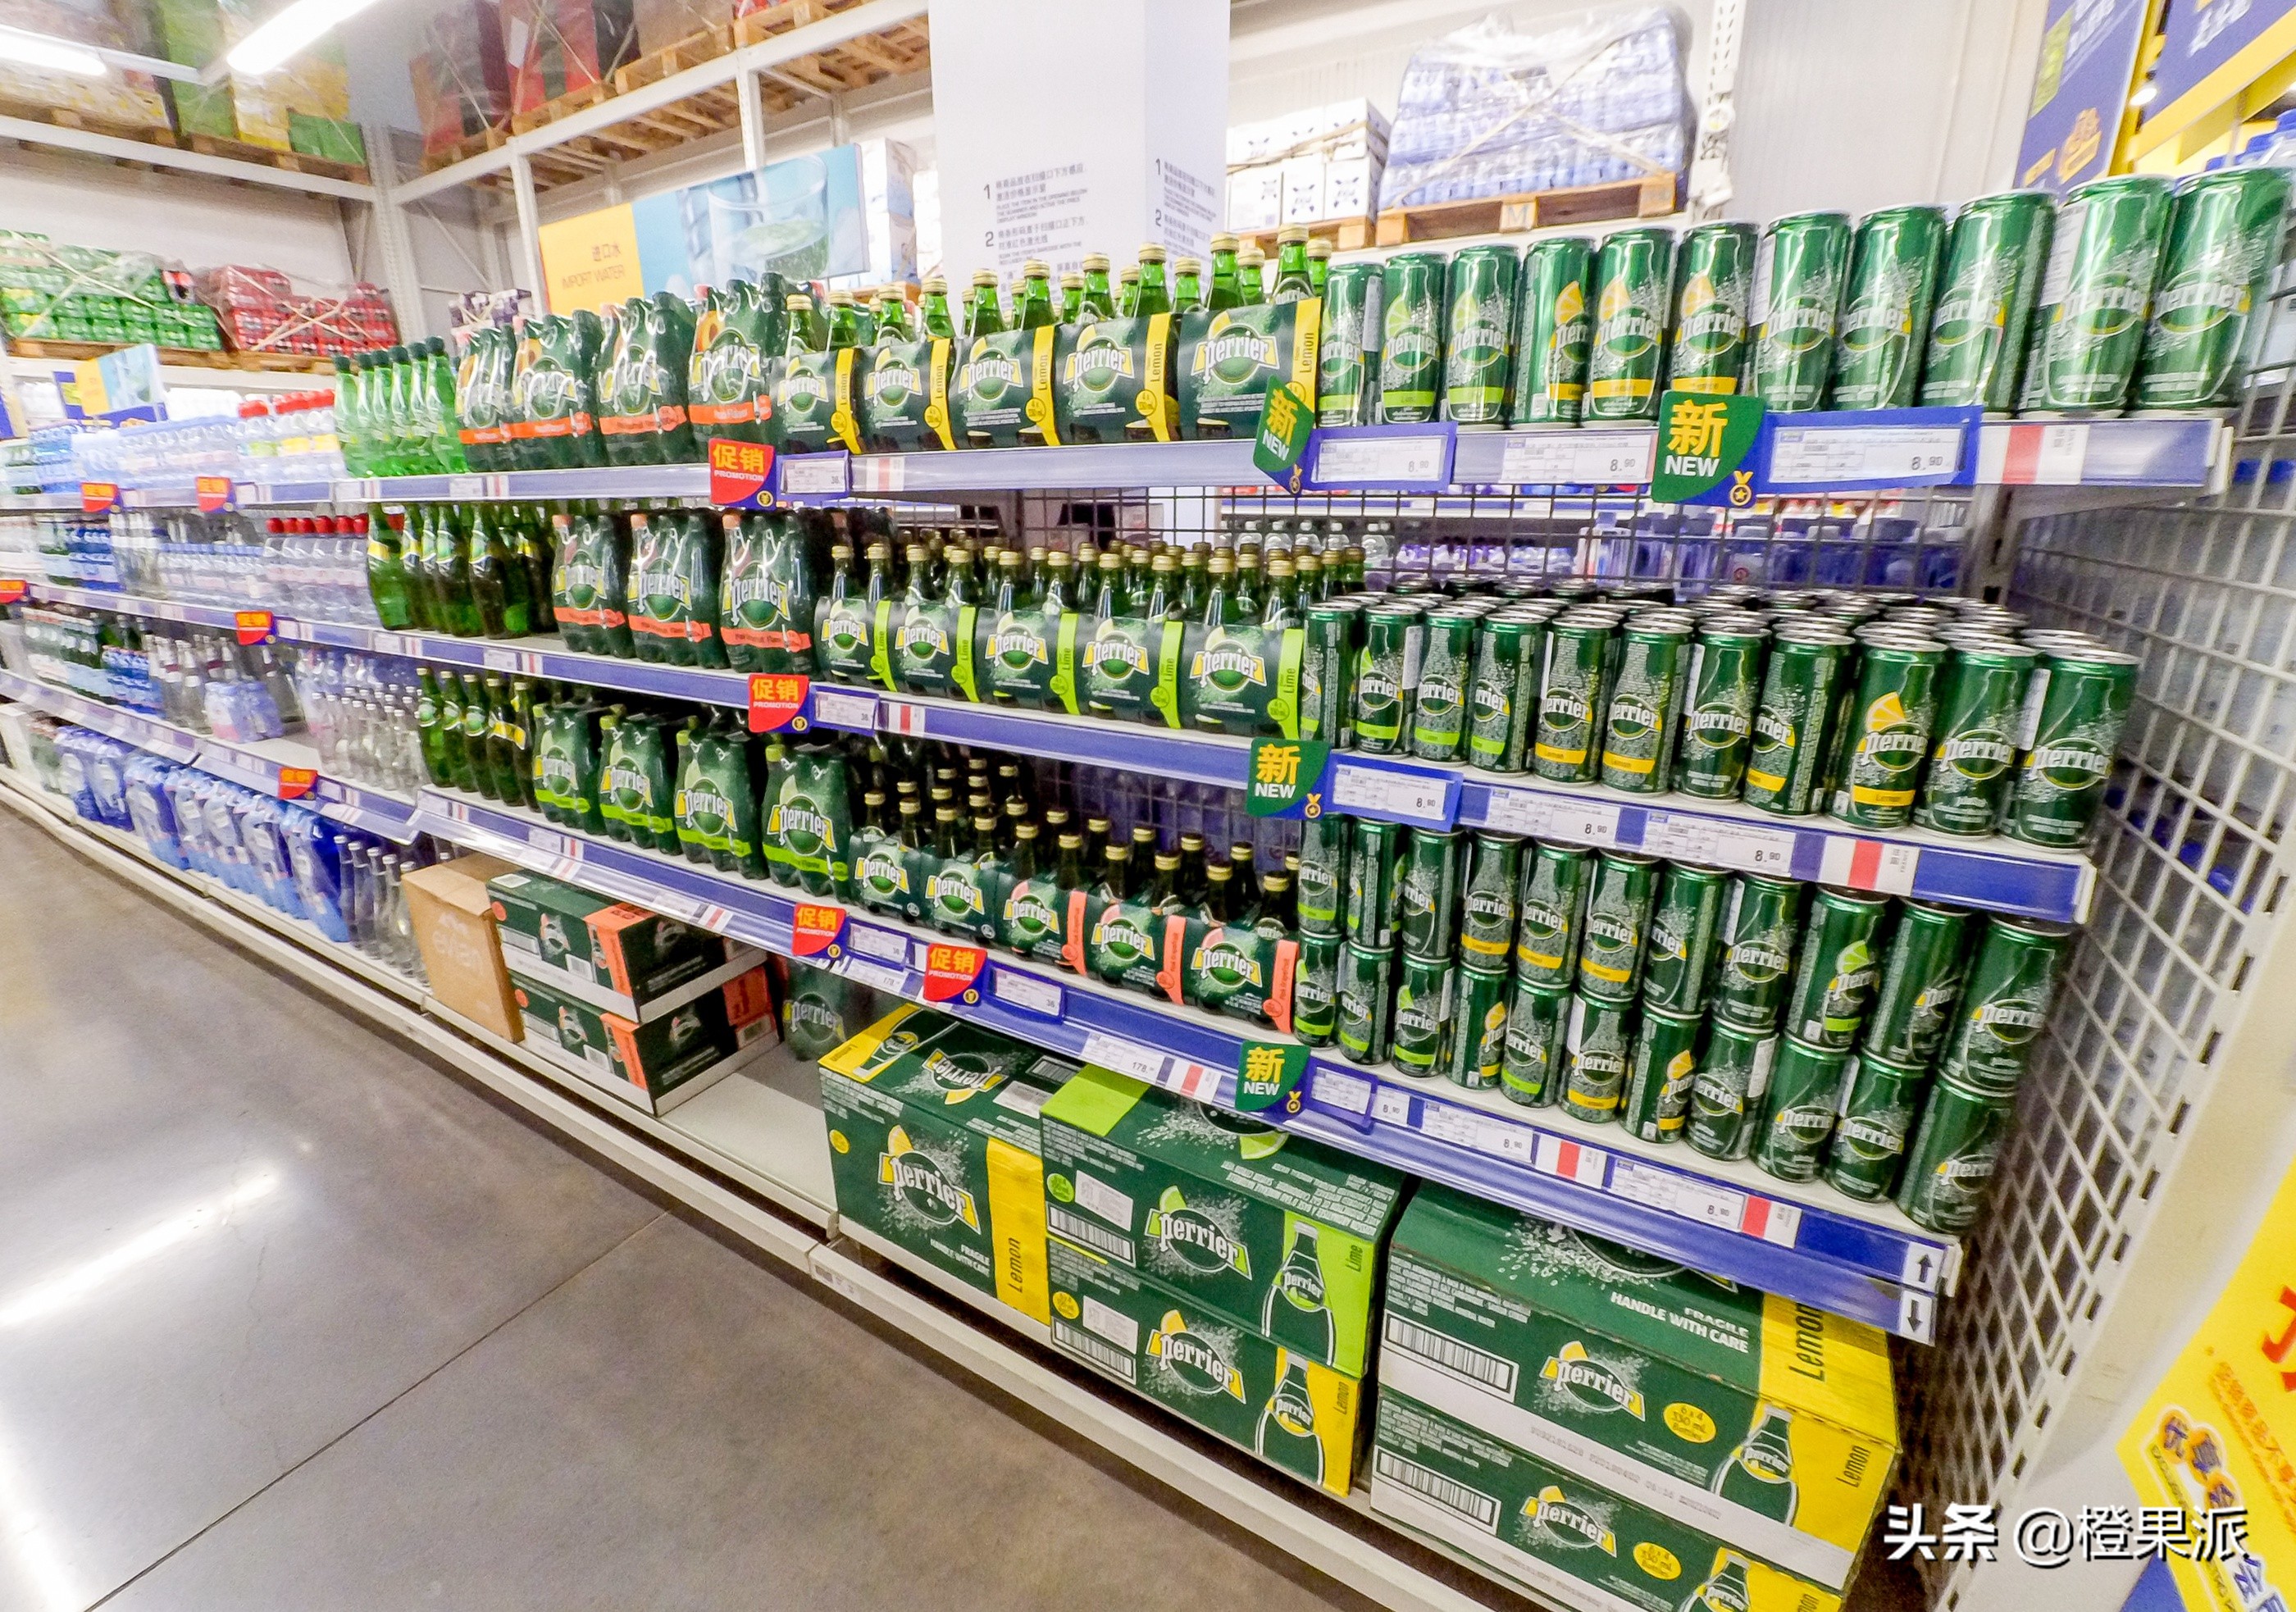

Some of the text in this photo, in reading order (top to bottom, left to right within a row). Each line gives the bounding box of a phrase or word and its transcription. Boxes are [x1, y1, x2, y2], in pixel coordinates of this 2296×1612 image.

[985, 230, 994, 248] 2
[1150, 343, 1162, 382] Lemon
[1204, 335, 1269, 385] perrier
[1300, 332, 1314, 373] Lemon
[967, 358, 1014, 401] perrier
[1038, 353, 1049, 391] Lemon
[1071, 347, 1126, 393] perrier
[873, 368, 914, 406] perrier
[1266, 388, 1299, 446] 新
[1667, 399, 1729, 458] 新
[713, 443, 765, 473] 促销
[1262, 429, 1290, 462] NEW
[713, 469, 764, 482] PROMOTION
[1610, 458, 1636, 471] 8.90
[1665, 454, 1720, 478] NEW
[1911, 455, 1943, 471] 8.90
[903, 626, 941, 657] perrier
[994, 634, 1040, 667] perrier
[1062, 647, 1072, 670] Lime
[1091, 641, 1141, 676] perrier
[1164, 658, 1175, 681] Lime
[1200, 650, 1258, 688] perrier
[751, 677, 799, 701] 促销
[1283, 667, 1296, 694] Lime
[753, 701, 799, 709] PROMOTION
[1255, 743, 1301, 785] 新
[1254, 782, 1296, 799] NEW
[686, 789, 731, 828] perrier
[779, 804, 828, 846] perrier
[1755, 849, 1781, 863] 8.90
[795, 927, 836, 937] PROMOTION
[796, 906, 837, 931] 促销
[1100, 924, 1148, 954] perrier
[928, 969, 973, 982] PROMOTION
[929, 947, 977, 974] 促销
[1200, 949, 1254, 979] perrier
[1245, 1046, 1285, 1084] 新
[1243, 1081, 1280, 1096] NEW
[890, 1155, 967, 1218] perrier
[1159, 1212, 1239, 1267] perrier
[1008, 1237, 1023, 1293] Lemon
[1346, 1244, 1363, 1273] Lime
[1283, 1270, 1322, 1301] perrier
[1610, 1291, 1749, 1354] HANDLE WITH CARE
[1683, 1306, 1749, 1338] FRAGILE
[1789, 1303, 1826, 1382] Lemon
[1159, 1333, 1235, 1388] perrier
[1333, 1381, 1349, 1415] Lemon
[1553, 1360, 1636, 1409] perrier
[1836, 1445, 1870, 1488] Lemon
[1533, 1501, 1607, 1545] perrier
